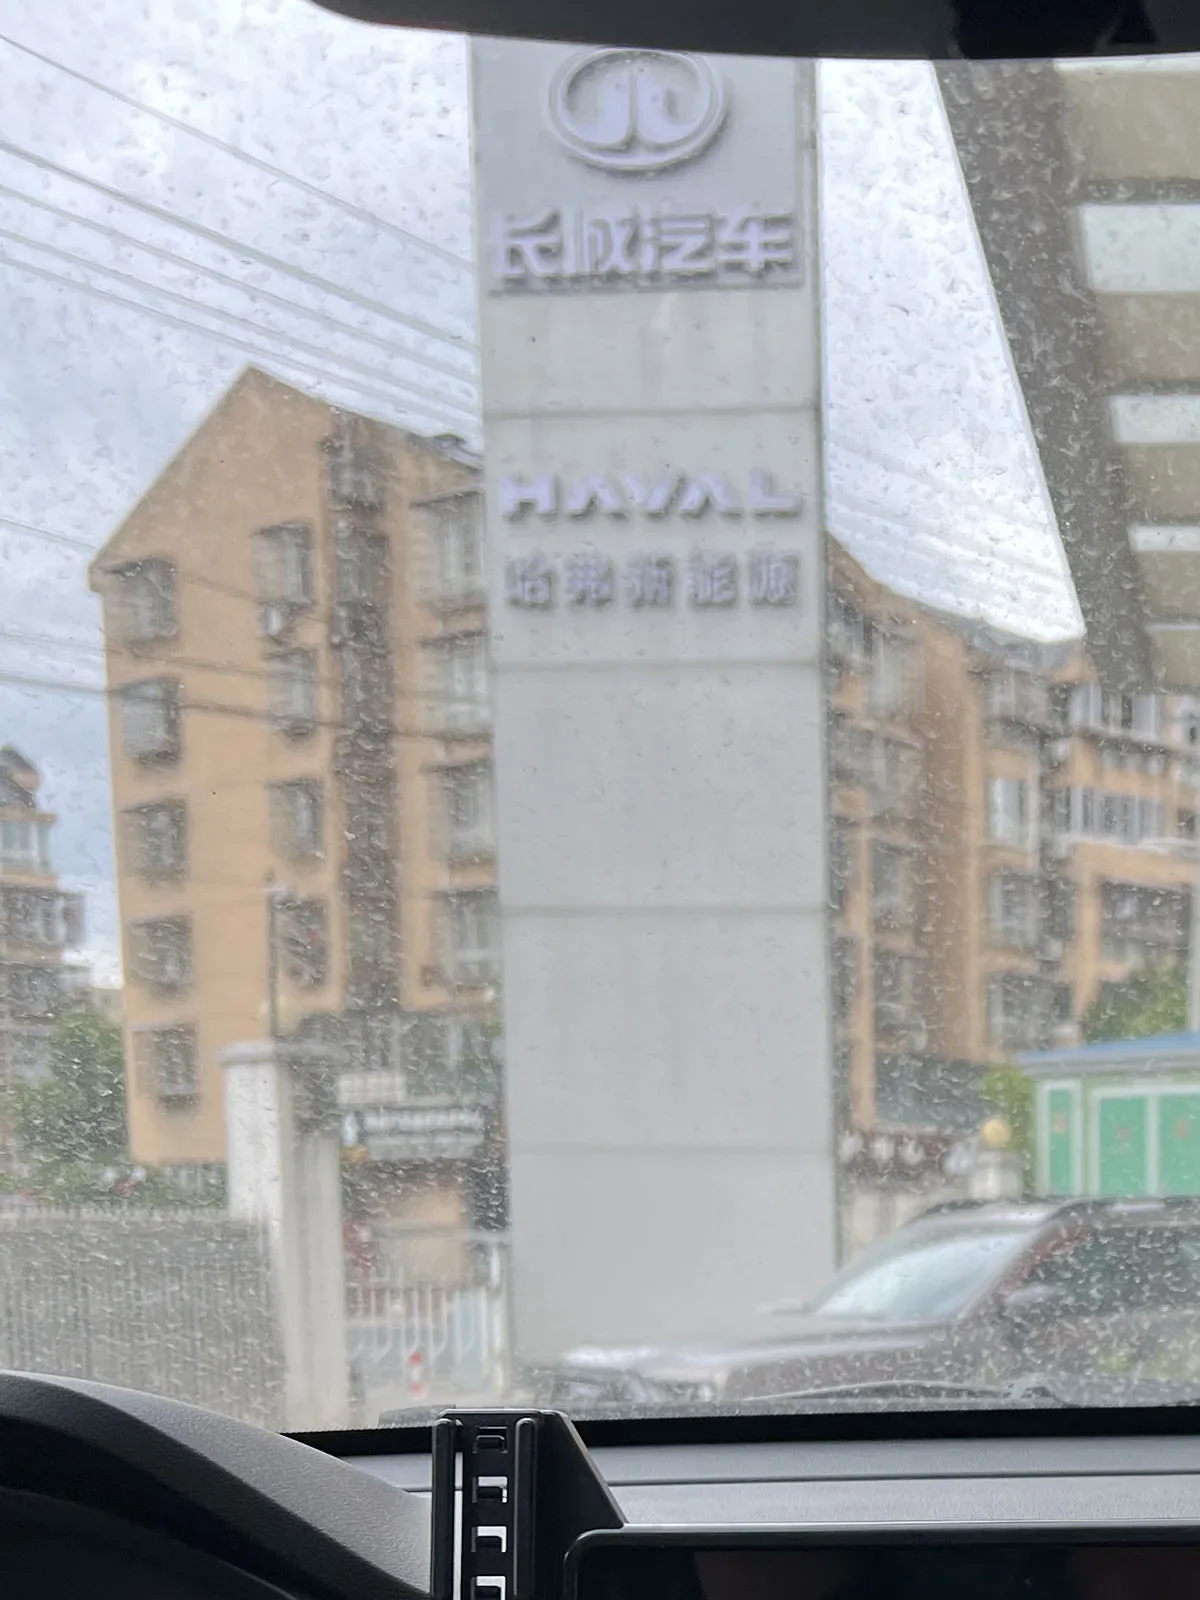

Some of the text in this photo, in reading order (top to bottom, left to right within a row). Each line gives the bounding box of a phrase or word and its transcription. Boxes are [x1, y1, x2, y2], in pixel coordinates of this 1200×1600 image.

[495, 206, 794, 274] 长城汽车
[500, 469, 800, 513] HAVAL
